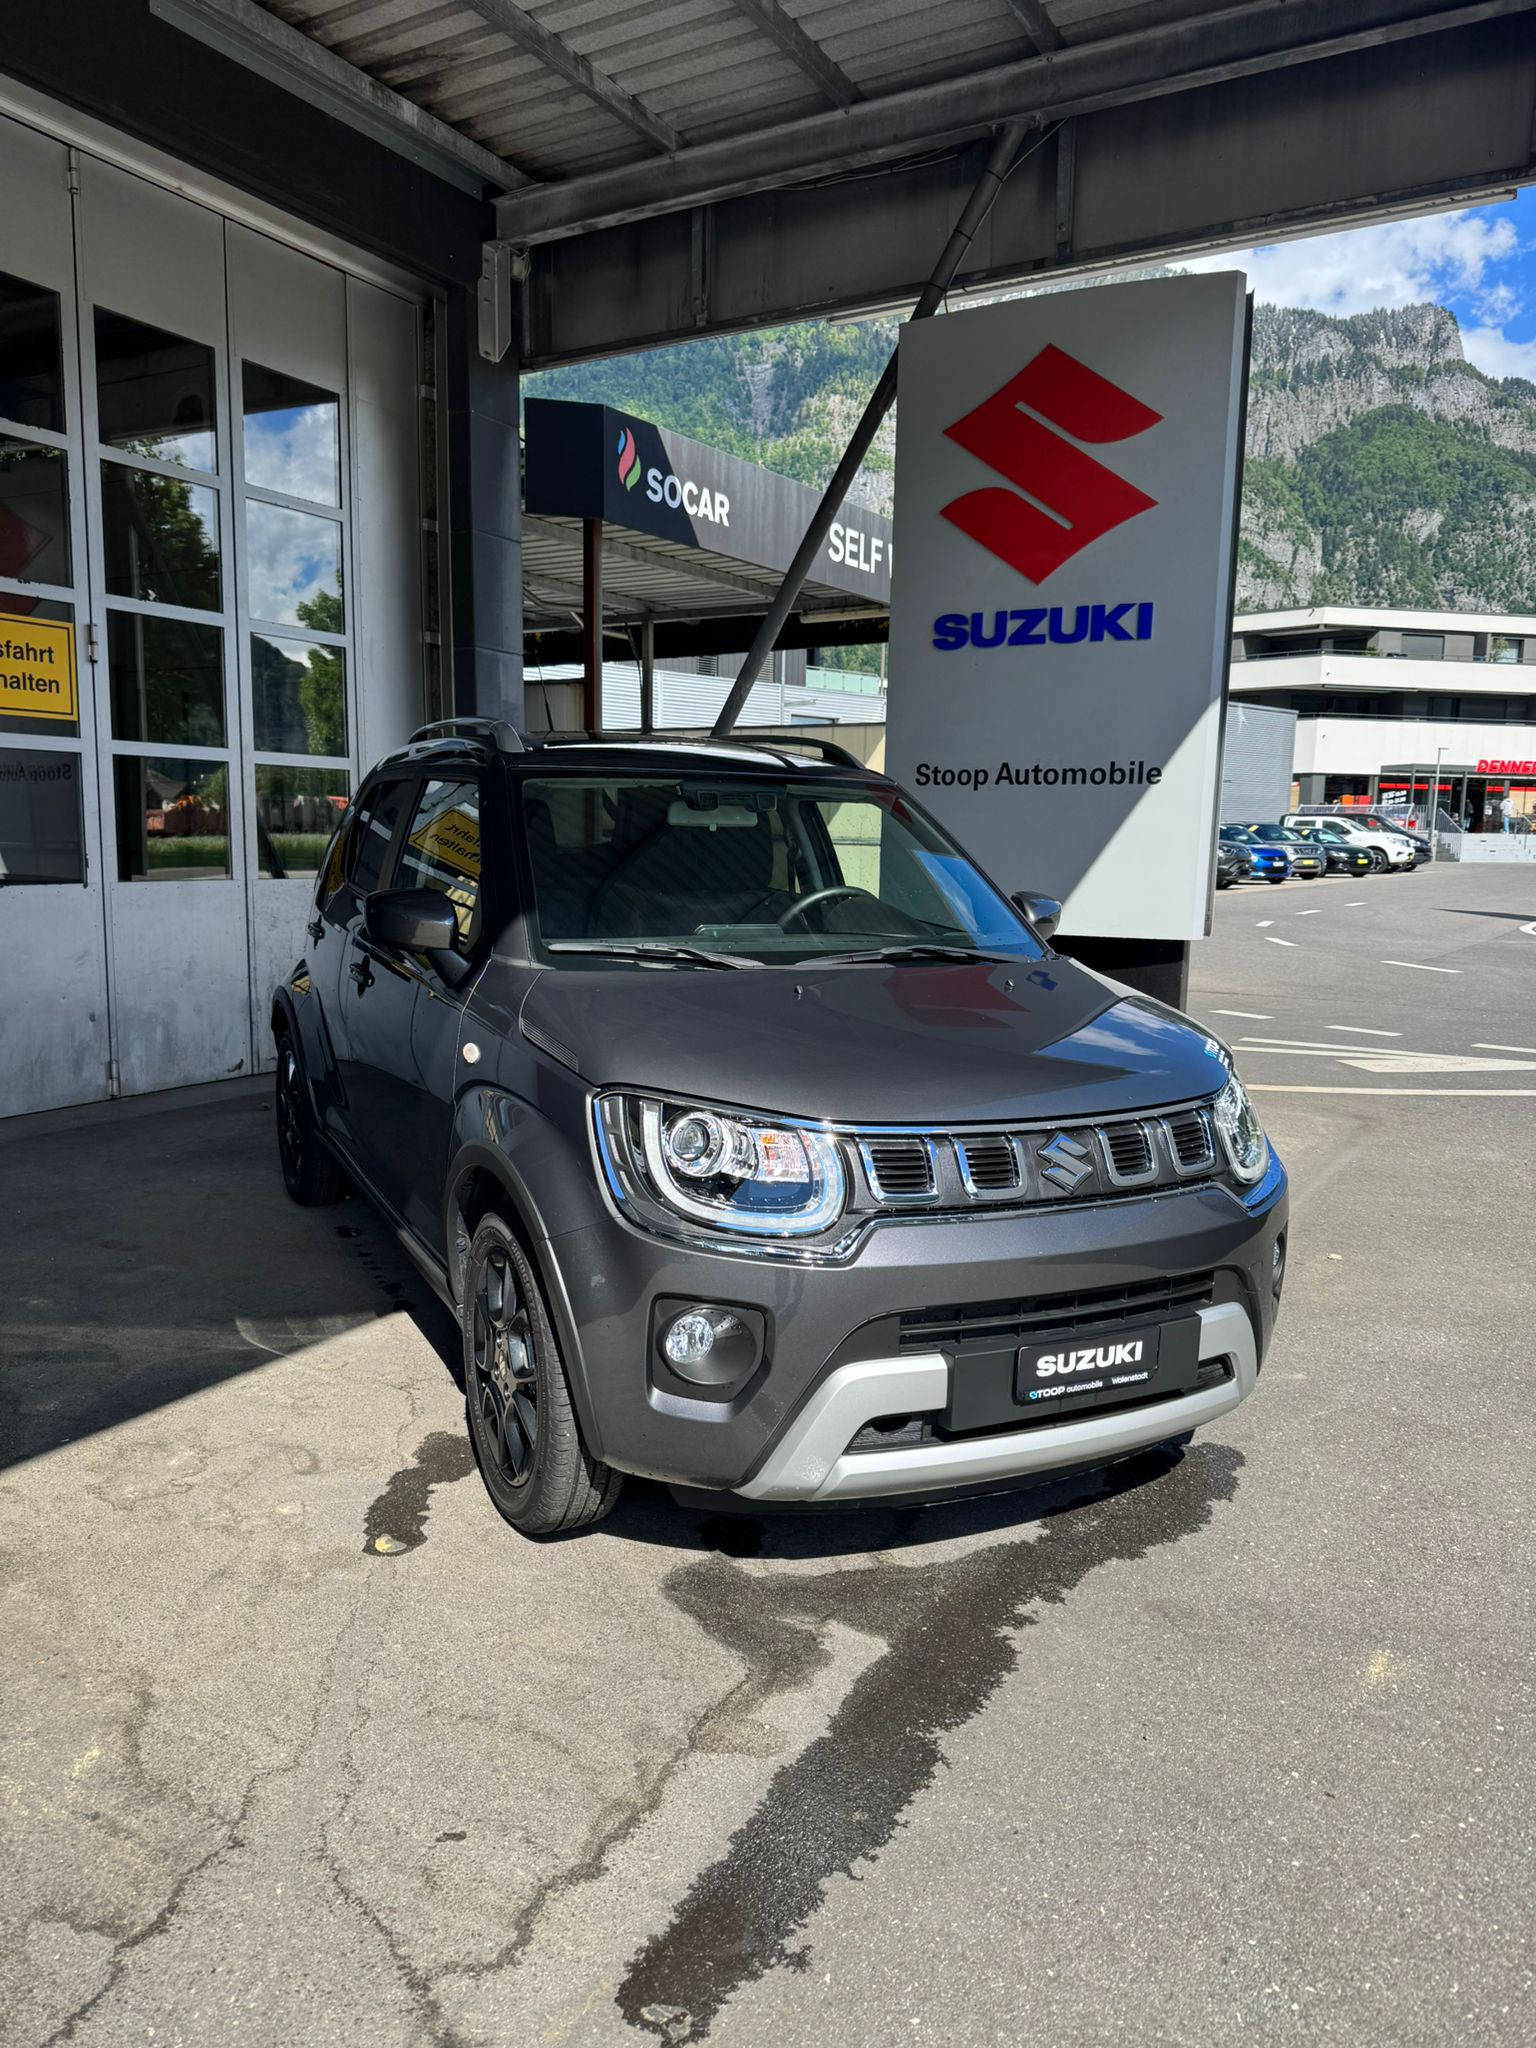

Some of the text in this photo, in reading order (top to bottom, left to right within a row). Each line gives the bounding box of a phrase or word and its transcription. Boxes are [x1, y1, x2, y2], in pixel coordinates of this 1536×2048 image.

[646, 467, 730, 527] SOCAR
[828, 522, 884, 574] SELF
[932, 602, 1154, 651] SUZUKI
[915, 761, 1162, 791] Stoop Automobile
[1036, 1341, 1143, 1377] SUZUKI
[1066, 1380, 1103, 1393] automobile
